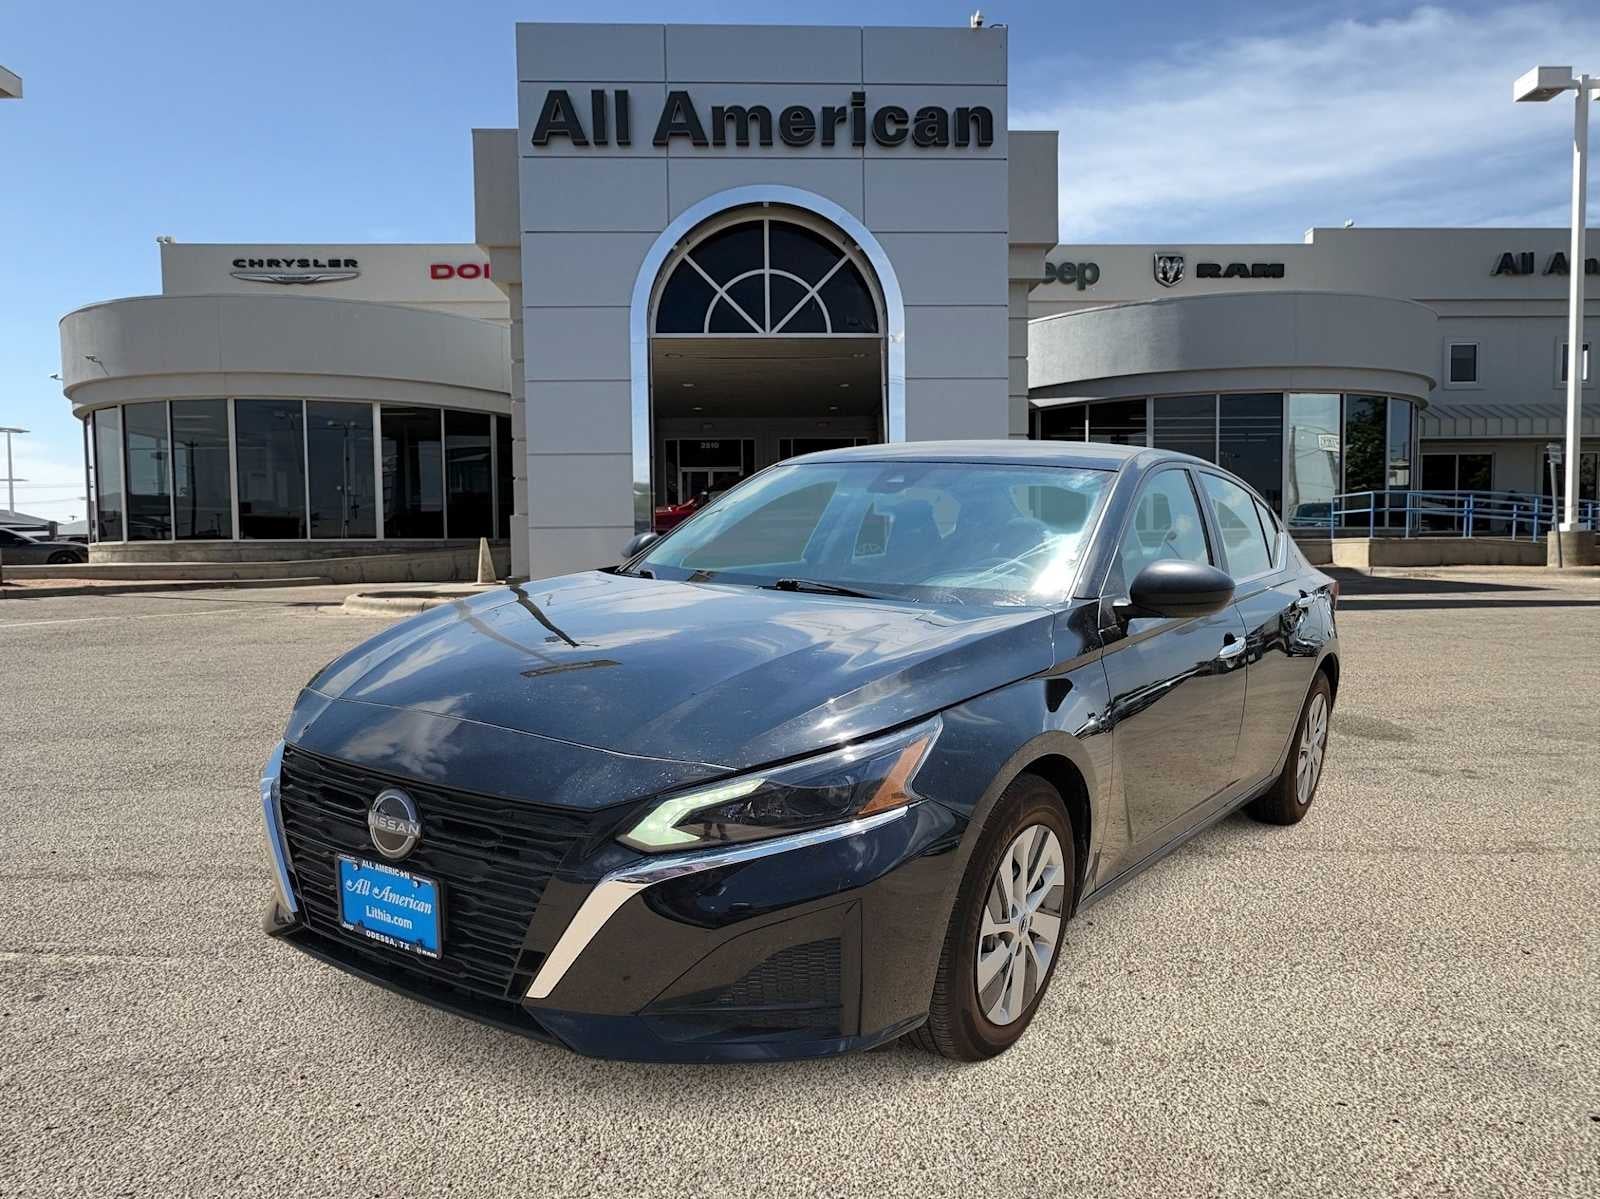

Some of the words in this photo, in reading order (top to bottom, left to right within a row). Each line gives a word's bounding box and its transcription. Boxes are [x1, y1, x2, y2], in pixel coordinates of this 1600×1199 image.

[531, 88, 632, 147] All
[652, 90, 994, 148] American
[232, 257, 359, 269] CHRYSLER
[430, 263, 490, 280] DO
[1196, 262, 1285, 279] RAM
[1492, 251, 1535, 275] All
[1040, 261, 1100, 292] eep
[367, 811, 420, 836] NISSAN
[361, 860, 375, 870] ALL
[345, 878, 371, 897] All
[372, 885, 433, 915] American
[366, 905, 413, 929] Lithia.com
